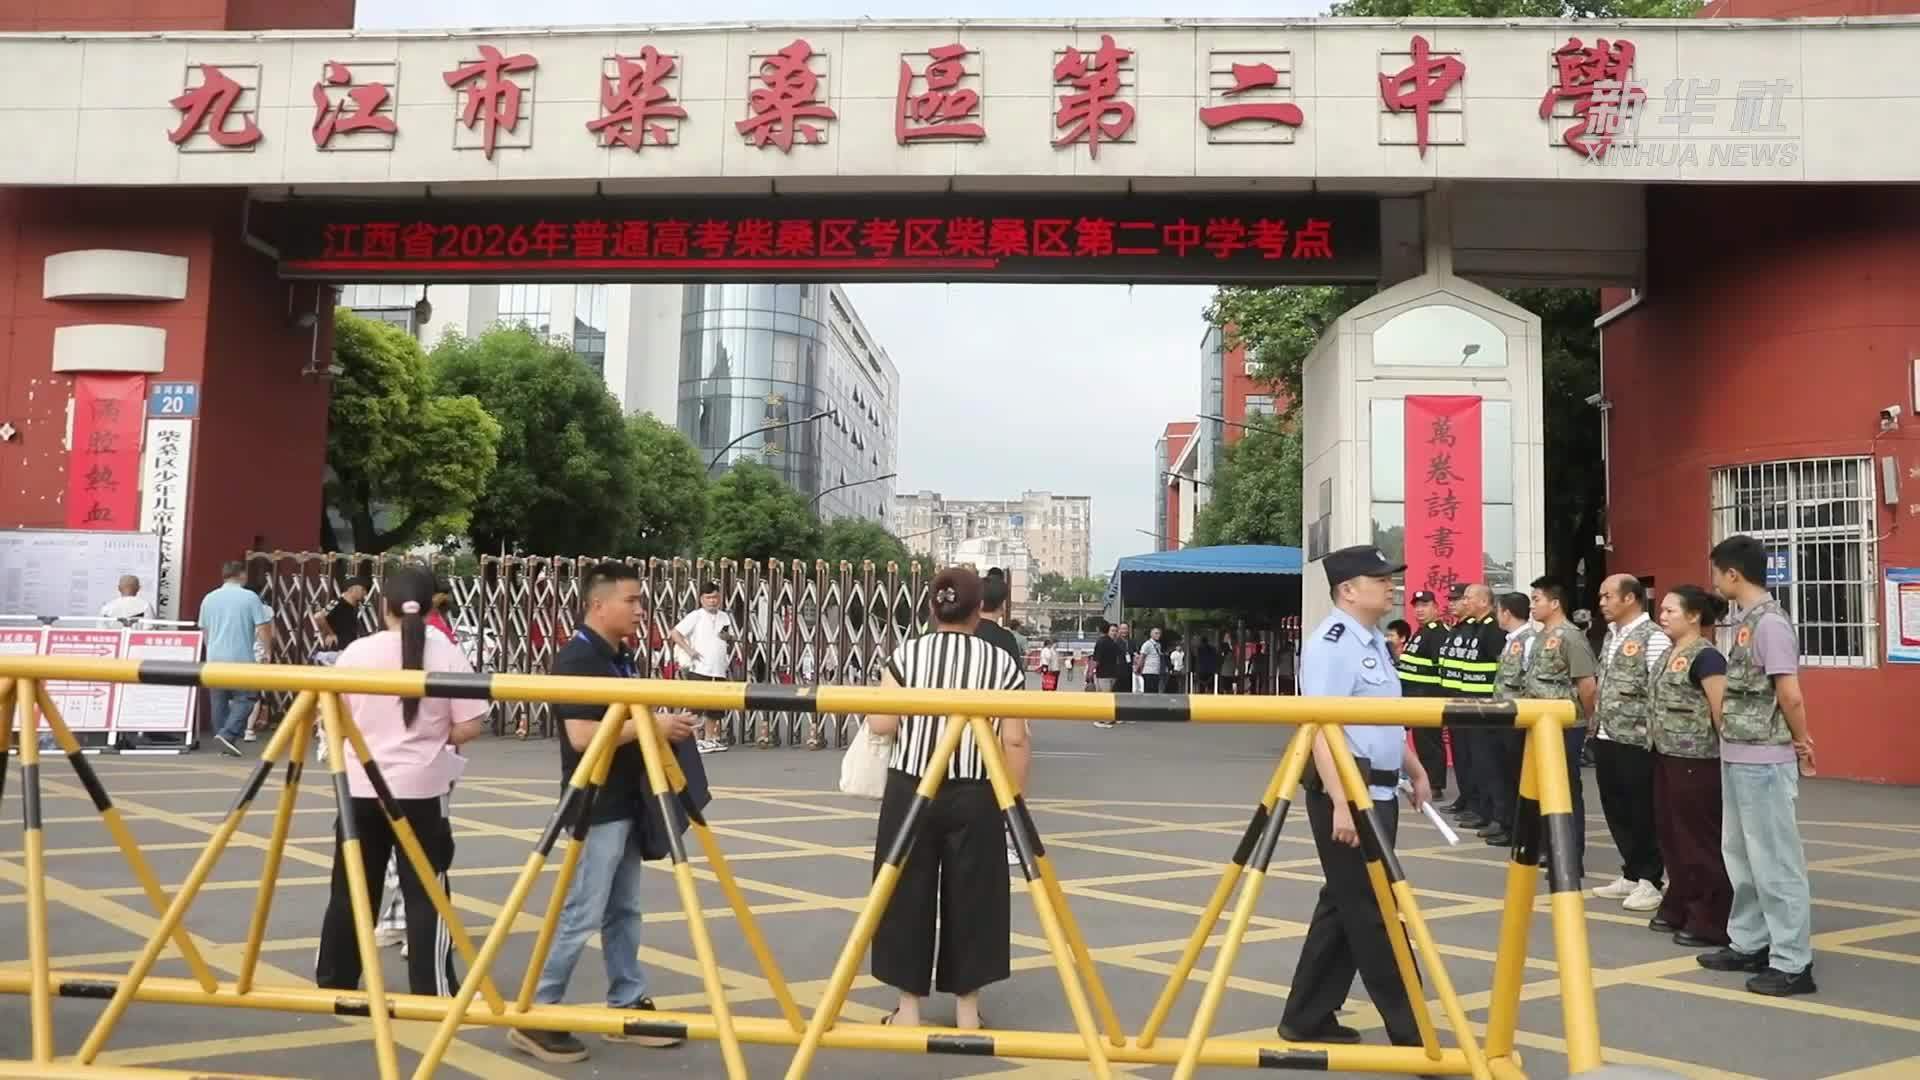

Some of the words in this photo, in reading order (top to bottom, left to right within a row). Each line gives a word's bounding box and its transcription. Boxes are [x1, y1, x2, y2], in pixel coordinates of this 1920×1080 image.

[322, 217, 1333, 262] 江西省2026年普通高考柴桑区考区柴桑区第二中学考点
[161, 396, 184, 413] 20
